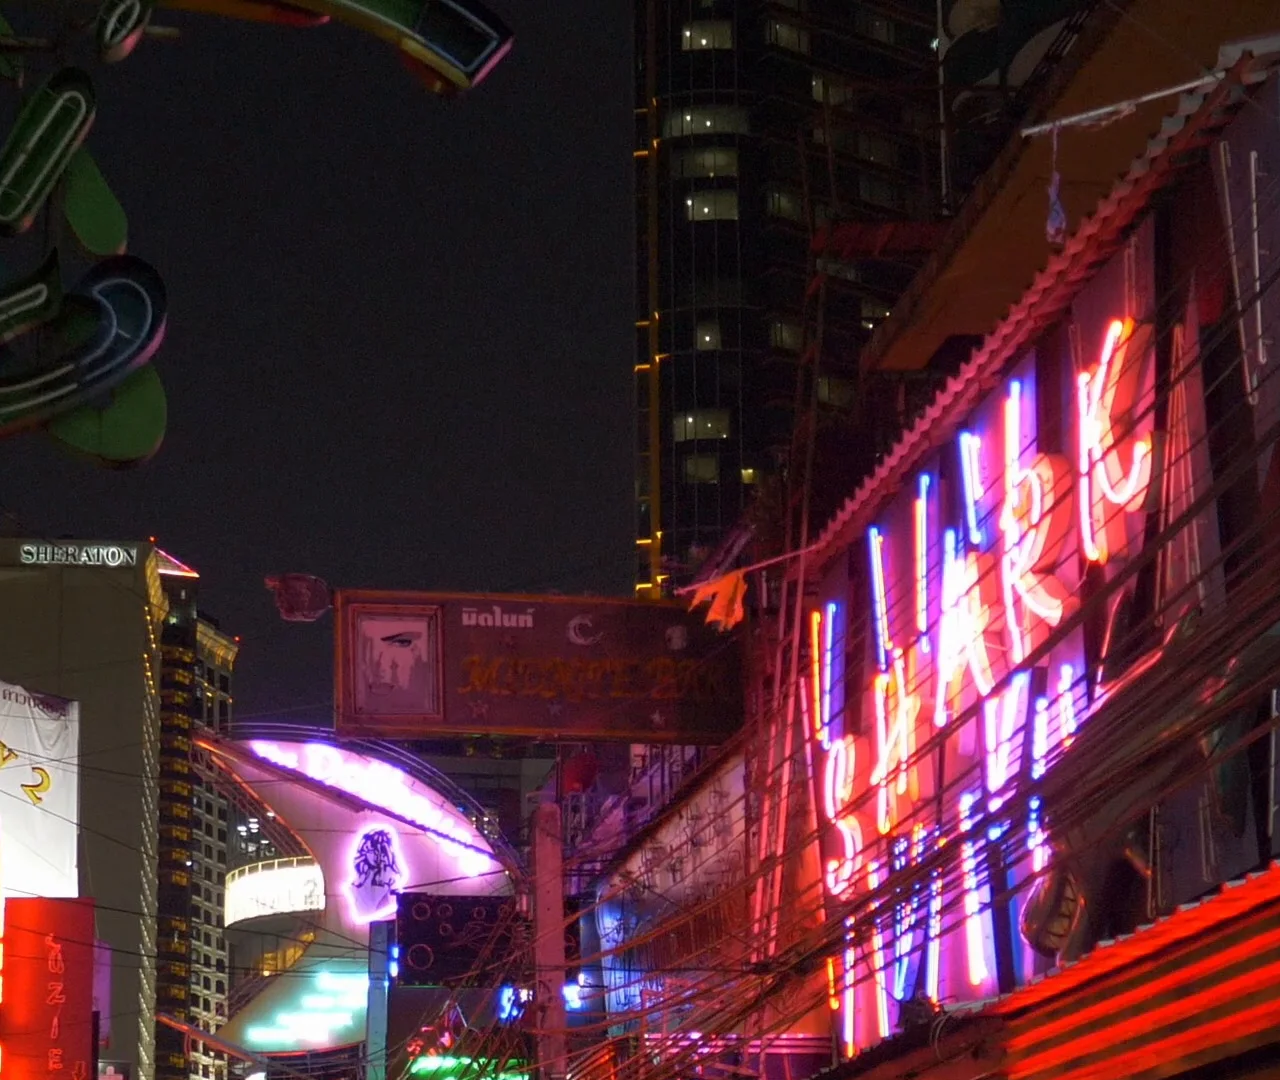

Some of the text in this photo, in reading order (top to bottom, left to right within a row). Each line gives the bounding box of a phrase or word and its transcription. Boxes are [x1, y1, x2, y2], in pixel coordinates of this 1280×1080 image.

[21, 544, 138, 566] SHERATON
[823, 318, 1154, 900] SHARK
[21, 766, 51, 805] 2
